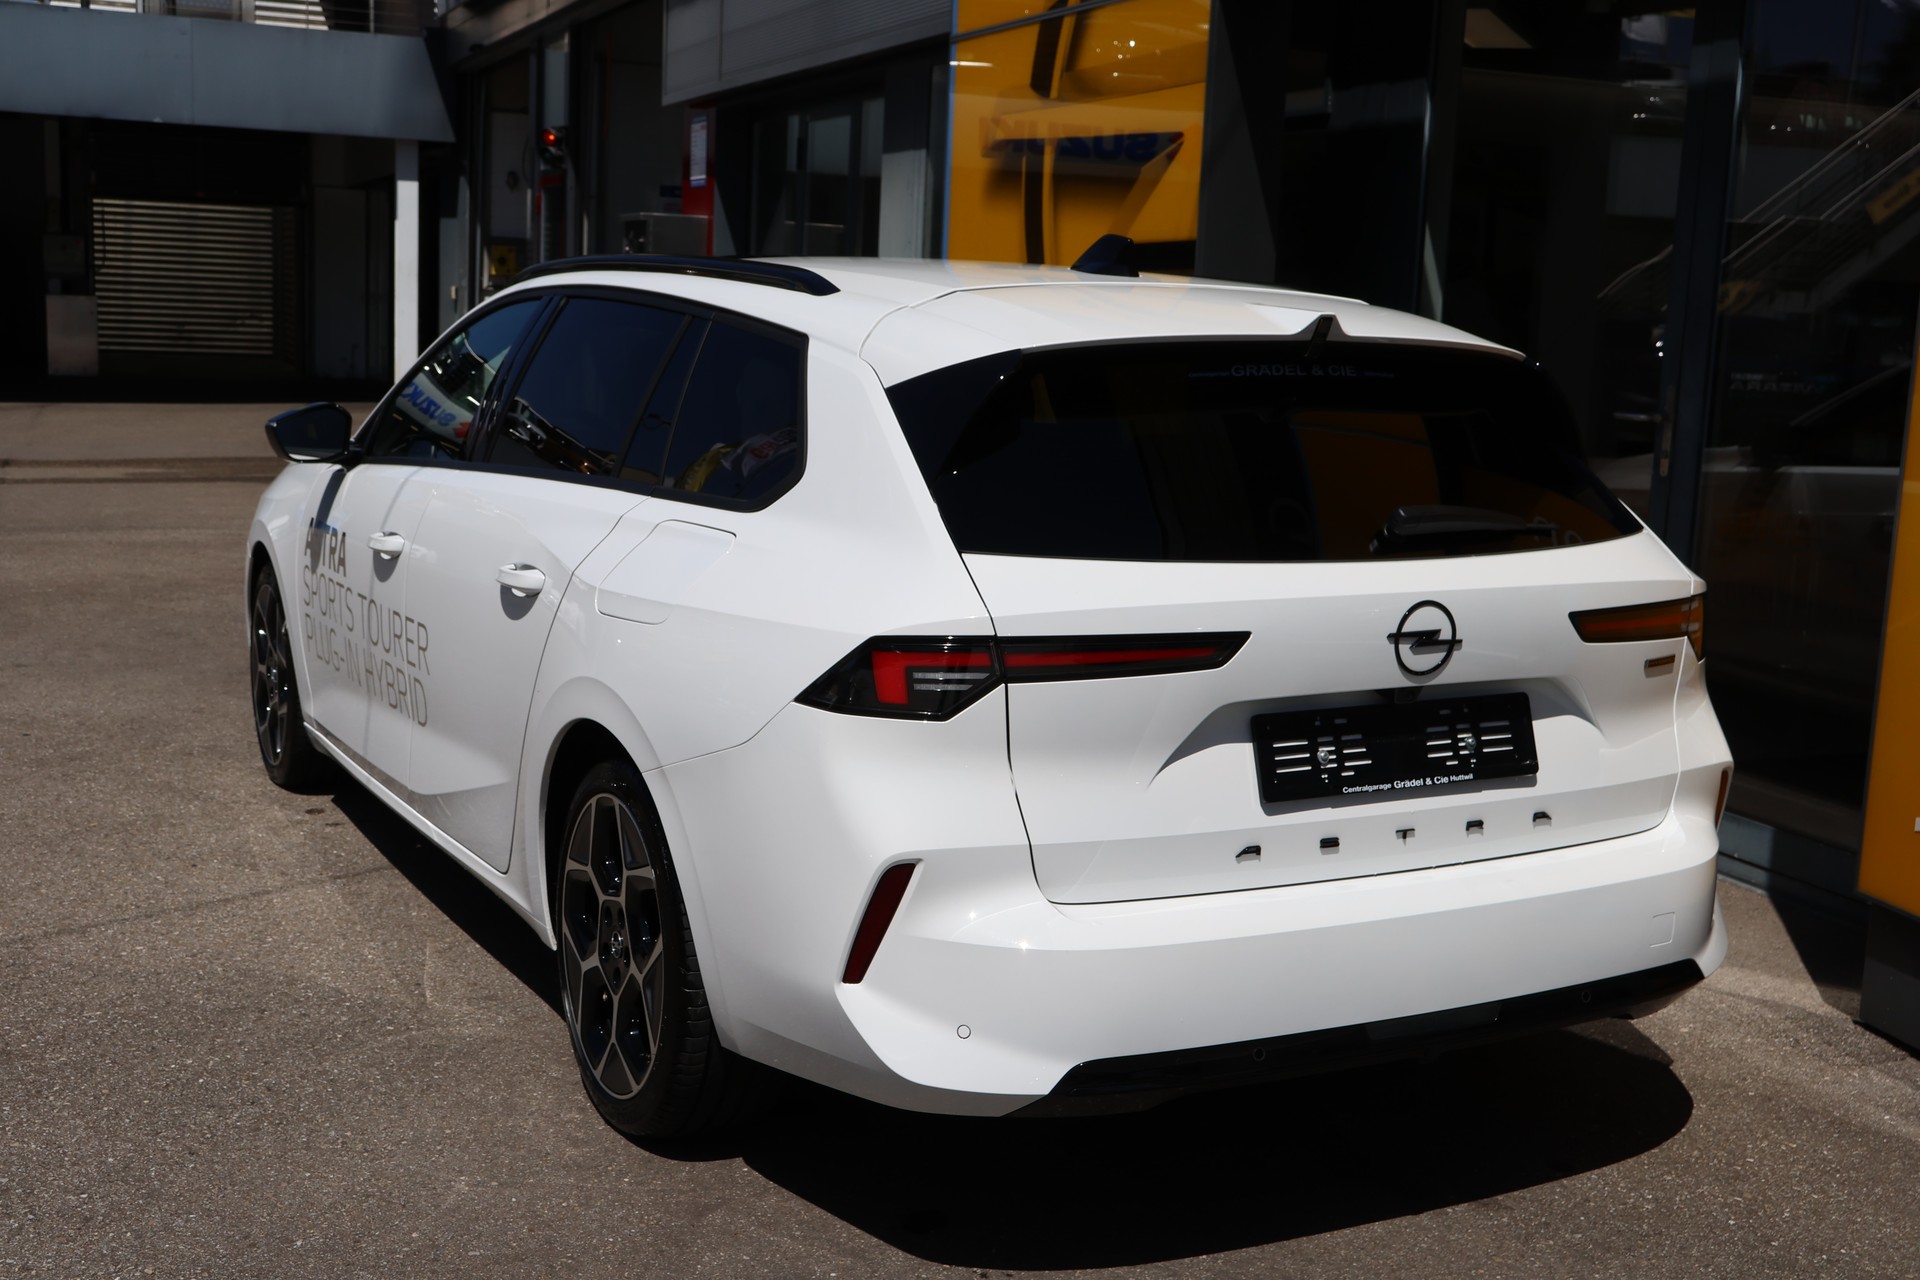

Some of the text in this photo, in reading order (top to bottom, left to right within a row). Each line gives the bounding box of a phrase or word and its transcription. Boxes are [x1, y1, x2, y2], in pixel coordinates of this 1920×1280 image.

[1311, 364, 1325, 377] &
[304, 516, 347, 578] ATRA
[303, 564, 430, 676] SPORTS TOURER
[363, 648, 429, 727] HYBRID
[1342, 772, 1474, 794] Centralgarage Grädel & Cie Huttwil
